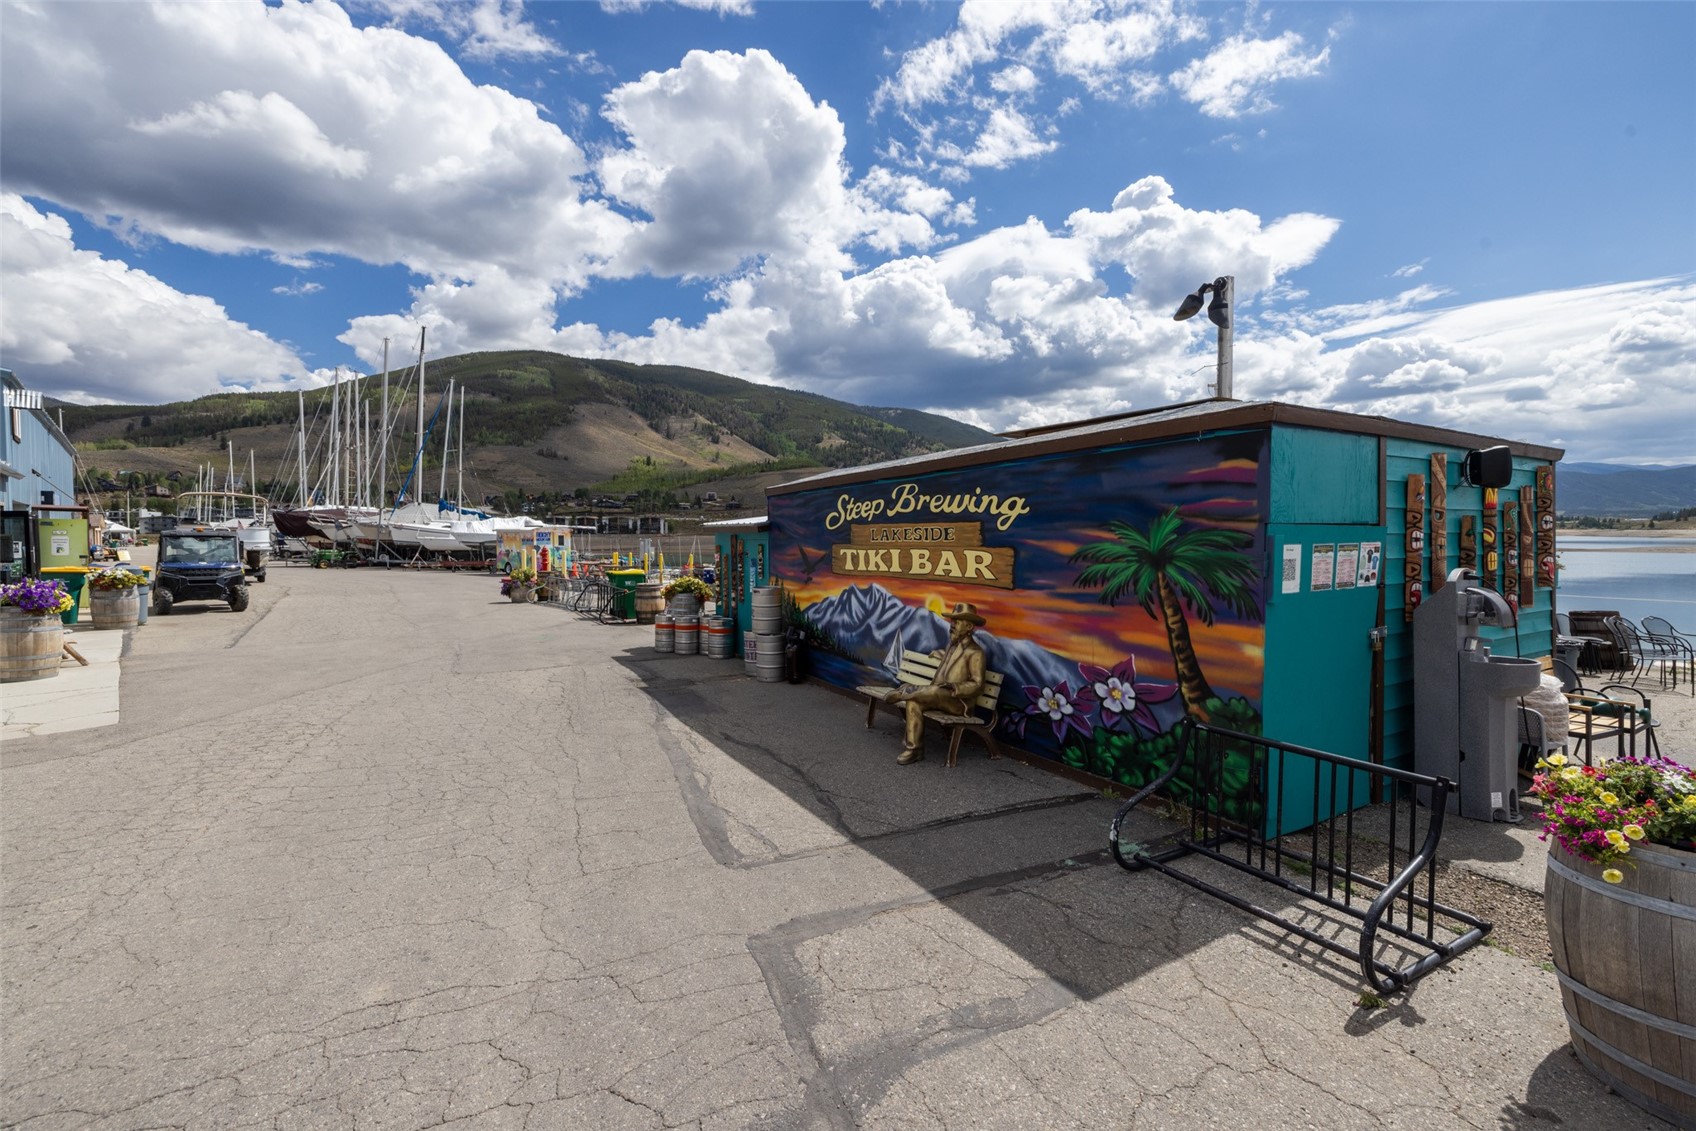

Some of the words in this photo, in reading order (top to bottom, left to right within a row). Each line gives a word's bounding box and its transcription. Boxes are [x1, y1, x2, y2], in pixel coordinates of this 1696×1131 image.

[825, 494, 885, 531] Steep
[887, 483, 1030, 531] Brewing
[870, 527, 955, 543] LAKESIDE
[840, 548, 903, 574] TIKI
[908, 549, 998, 581] BAR
